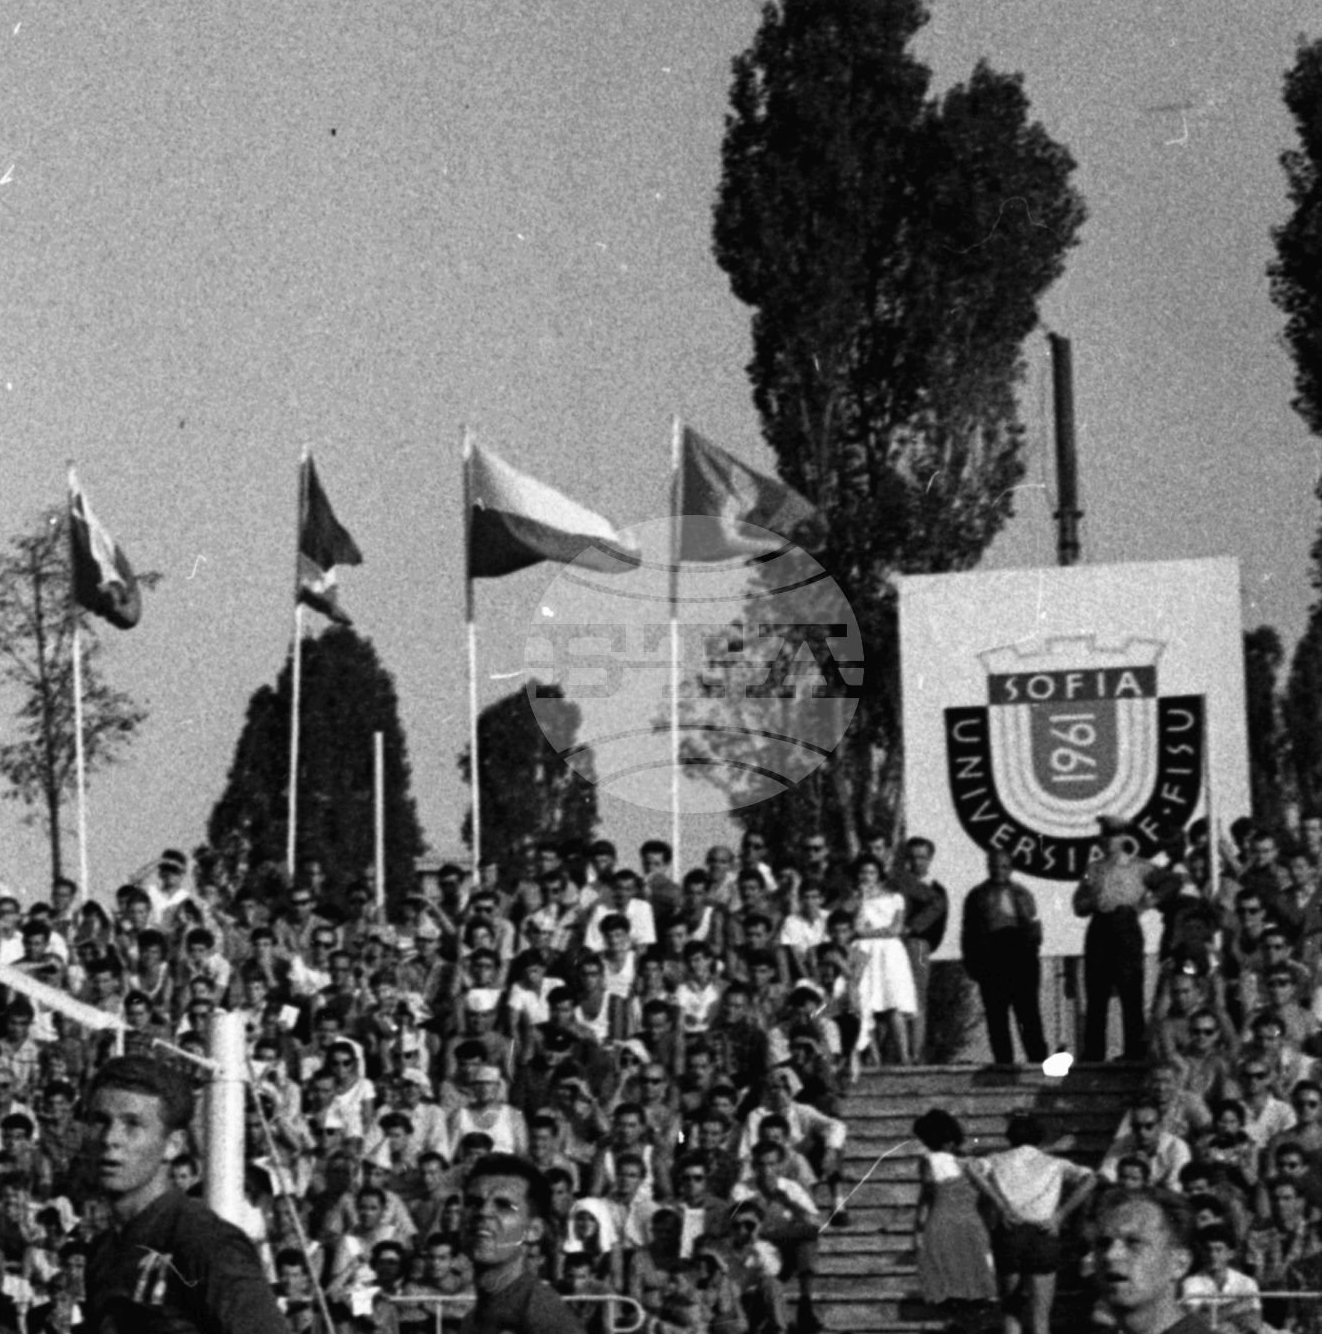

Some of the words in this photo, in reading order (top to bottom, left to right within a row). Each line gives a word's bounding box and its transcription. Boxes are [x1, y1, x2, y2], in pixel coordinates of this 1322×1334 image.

[1004, 671, 1143, 702] SOFIA
[1048, 713, 1097, 782] 1961
[1160, 709, 1195, 804] FISU
